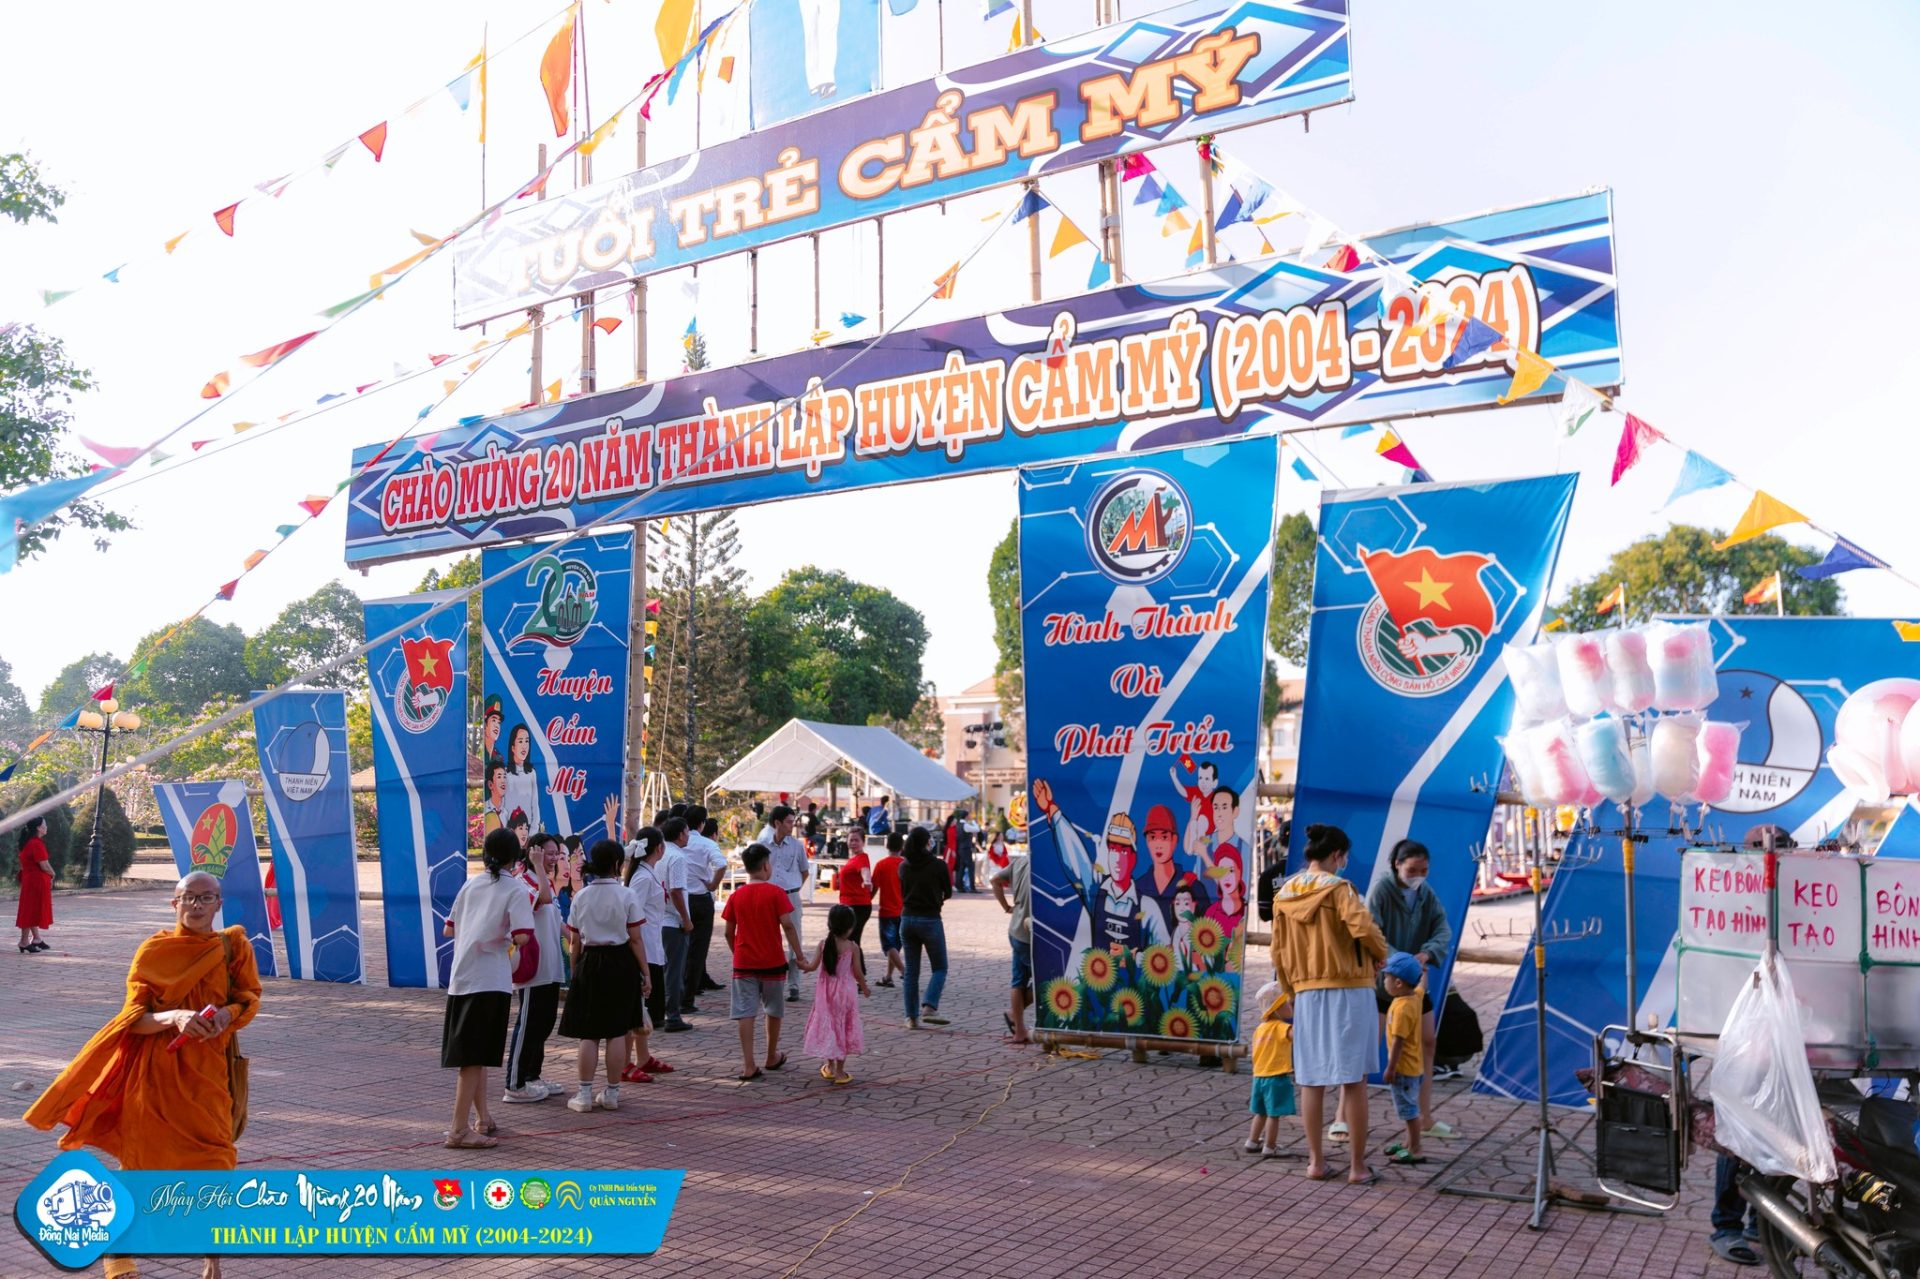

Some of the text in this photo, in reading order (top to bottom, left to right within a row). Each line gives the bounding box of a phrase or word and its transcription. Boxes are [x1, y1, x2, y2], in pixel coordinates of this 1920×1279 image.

[672, 148, 822, 248] TRẺ
[835, 88, 1060, 200] CẨM
[1079, 27, 1261, 143] MỸ
[380, 455, 455, 533] CHÀO
[456, 446, 541, 518] MỪNG
[545, 446, 577, 500] 20
[579, 422, 654, 496] NĂM
[656, 400, 773, 482] THÀNH
[777, 380, 856, 476] LẬP
[859, 352, 1005, 456] HUYỆN
[1010, 313, 1115, 430] CẨM
[1124, 318, 1207, 410] MỸ
[1043, 598, 1238, 646] Hình Thành
[537, 667, 613, 702] Huyện
[546, 713, 597, 745] Cẩm
[1055, 714, 1233, 765] Phát Triển
[546, 766, 588, 801] Mỹ
[1739, 788, 1777, 802] NAM
[1750, 771, 1792, 788] NIÊN
[1694, 867, 1731, 899] KẸO
[1794, 878, 1839, 915] KẸO
[1690, 907, 1727, 937] TẠO
[1788, 922, 1836, 953] TẠO
